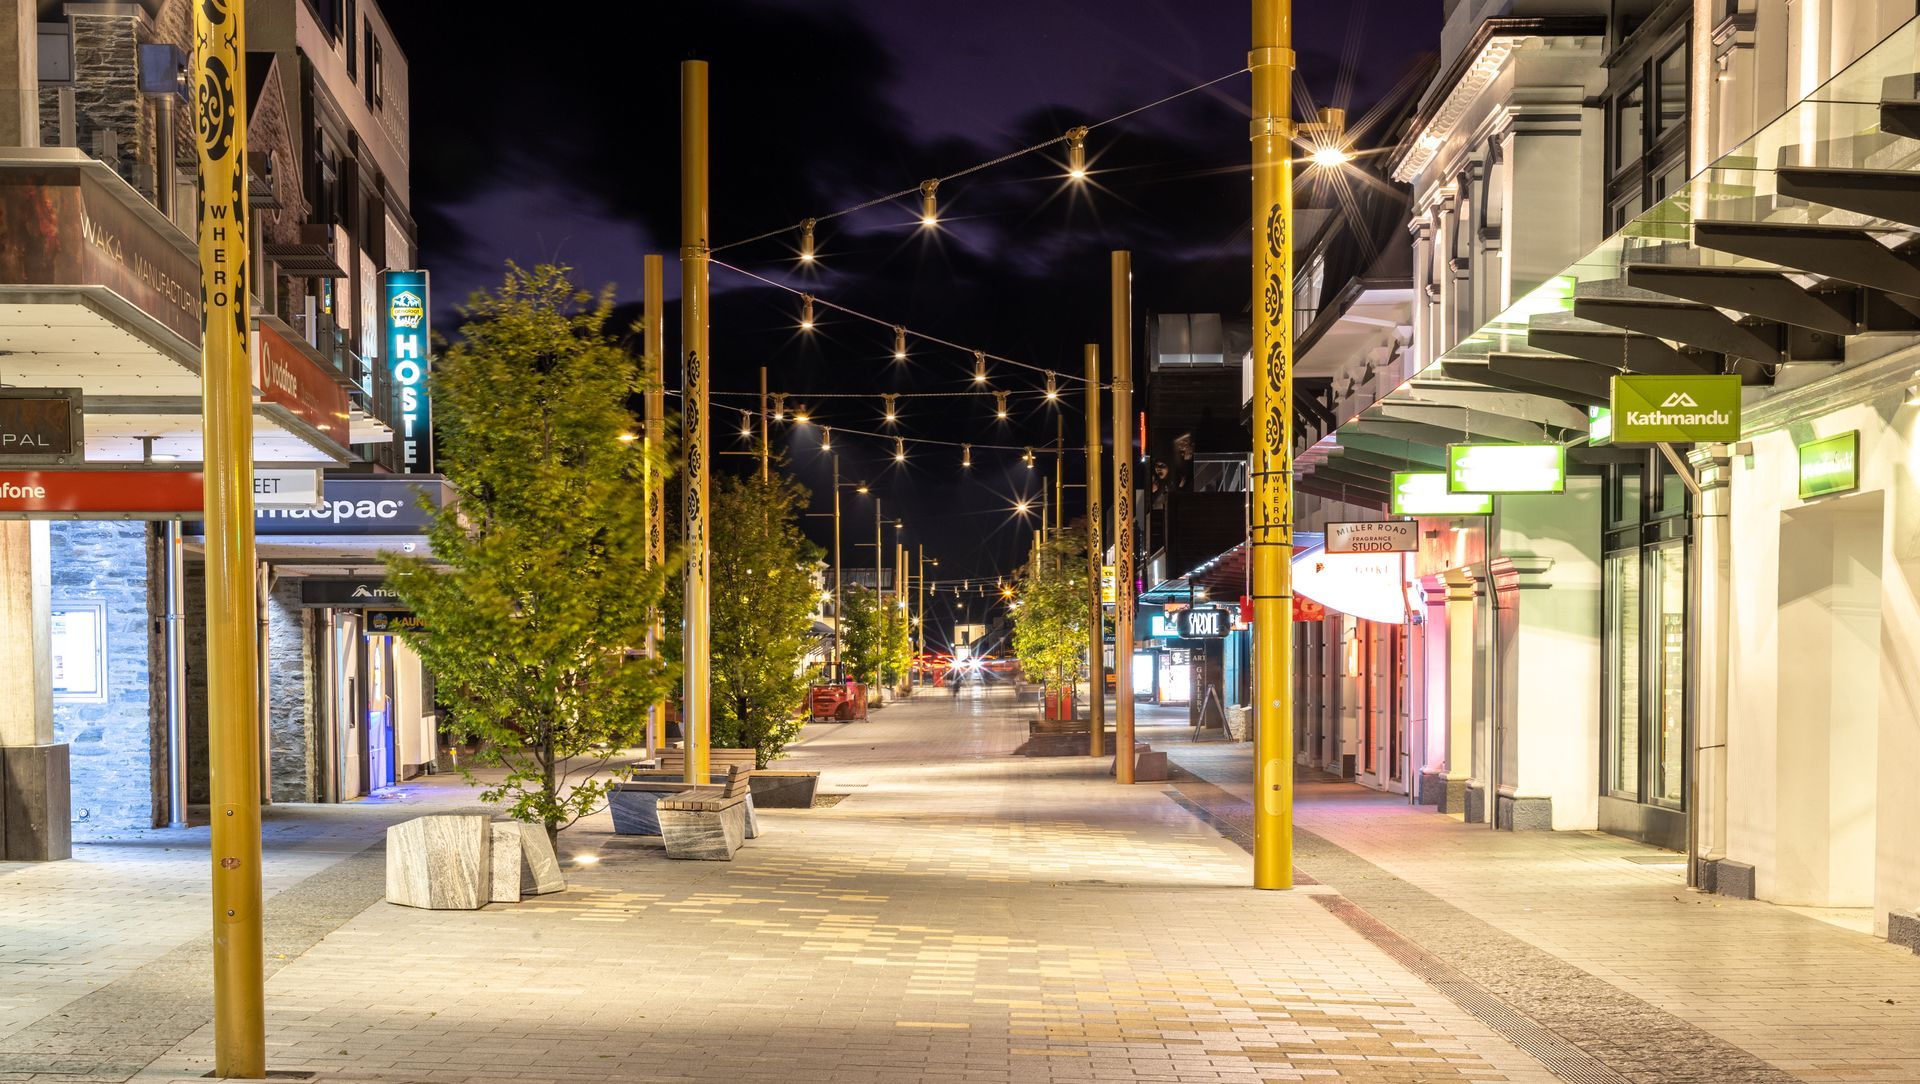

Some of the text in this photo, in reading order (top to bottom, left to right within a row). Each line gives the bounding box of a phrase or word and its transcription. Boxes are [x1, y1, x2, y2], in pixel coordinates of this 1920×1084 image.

[80, 212, 200, 320] WAKA MANUFACTURIN
[211, 205, 227, 307] WHERO
[272, 357, 297, 398] vodafone
[1626, 410, 1729, 426] Kathmandu
[0, 481, 46, 499] fone
[1271, 475, 1280, 524] WHERO
[1336, 523, 1408, 537] MILLER ROAD
[1352, 542, 1393, 551] STUDIO
